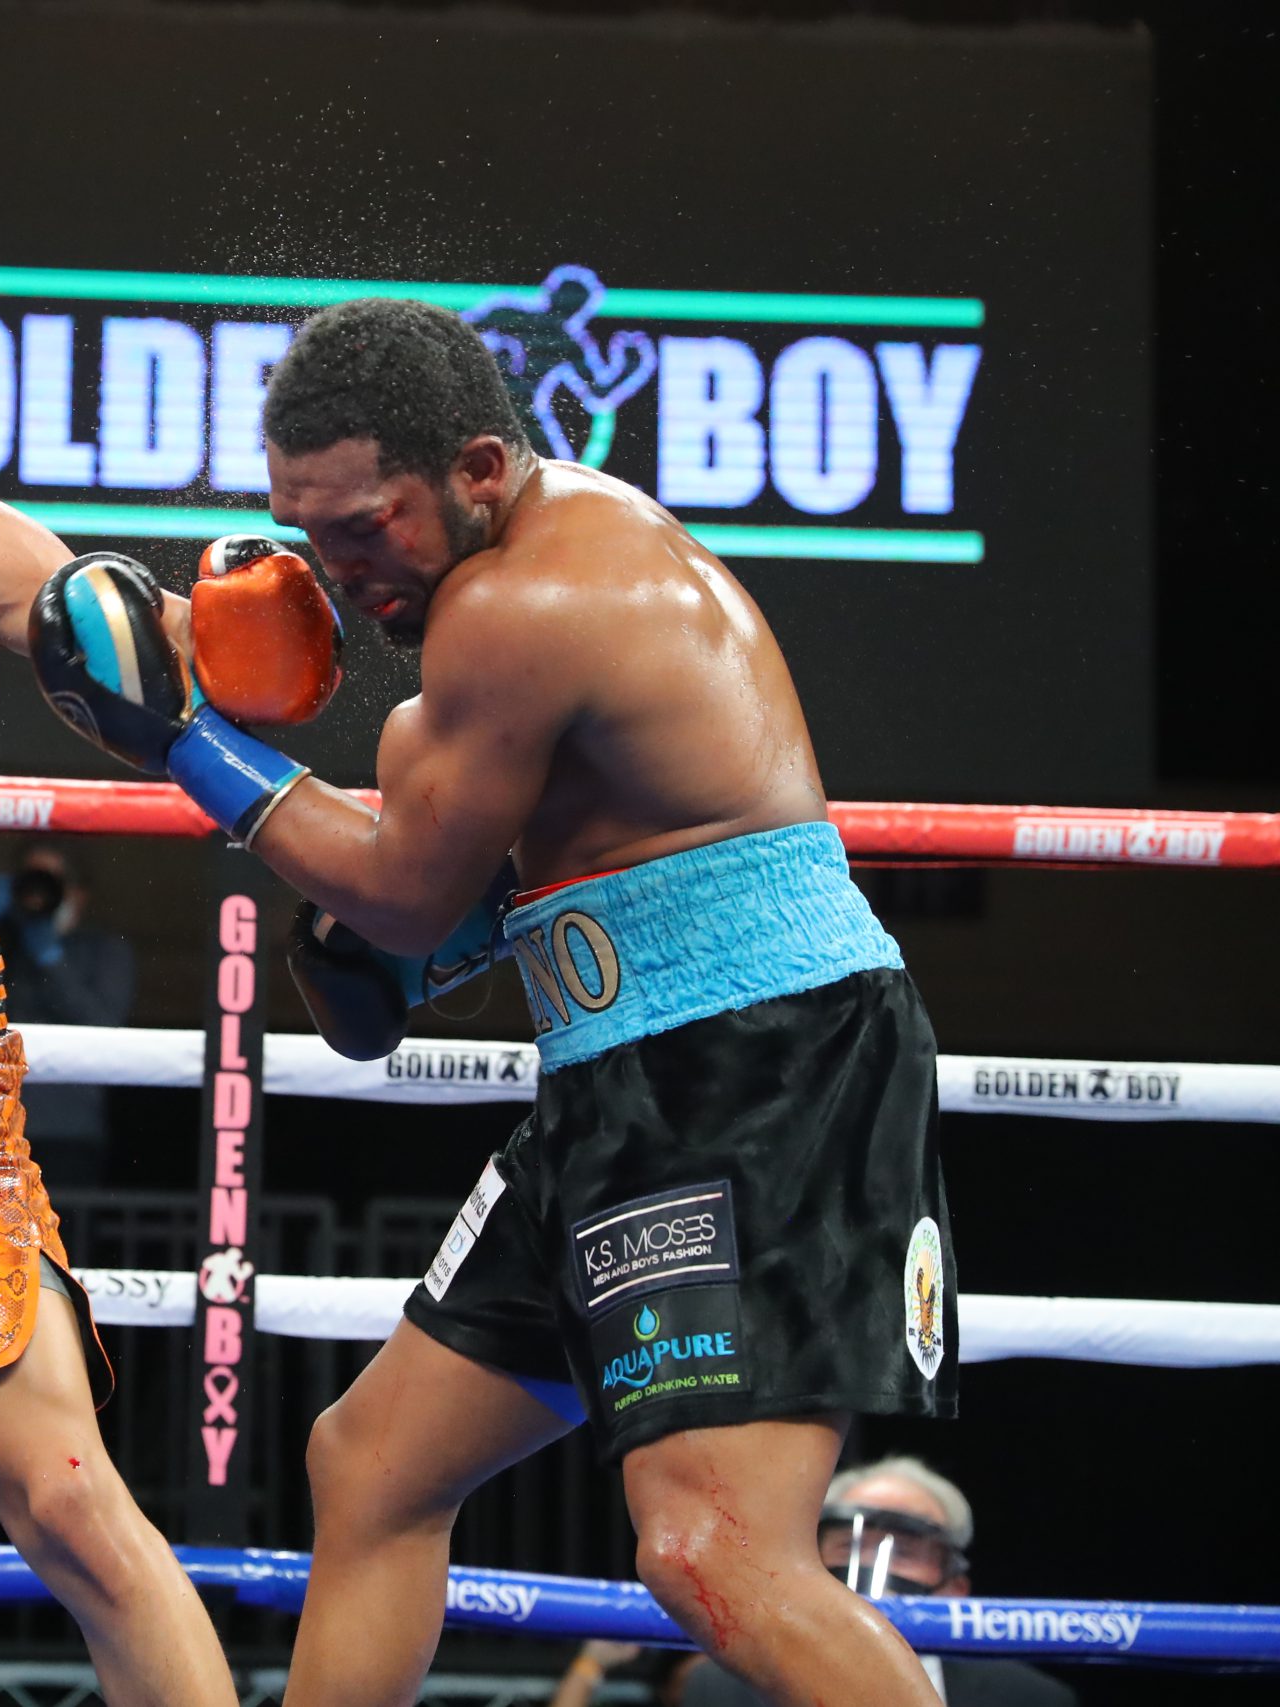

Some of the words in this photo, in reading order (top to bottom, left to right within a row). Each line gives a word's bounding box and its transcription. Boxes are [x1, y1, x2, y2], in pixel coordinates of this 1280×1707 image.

[657, 335, 982, 515] BOY
[1015, 825, 1123, 859] GOLDEN
[1166, 829, 1225, 864] BOY
[209, 895, 257, 1246] GOLDEN
[386, 1051, 491, 1082] GOLDEN
[974, 1070, 1079, 1099] GOLDEN
[1126, 1075, 1180, 1102] BOY
[623, 1213, 717, 1259] MOSES
[593, 1272, 611, 1288] MEN
[611, 1262, 630, 1279] AND
[631, 1253, 660, 1271] BOYS
[662, 1243, 713, 1263] FASHION
[602, 1331, 736, 1391] AQUAPURE
[645, 1376, 698, 1397] DRINKING
[700, 1373, 741, 1386] WATER
[948, 1600, 1144, 1651] Hennessy
